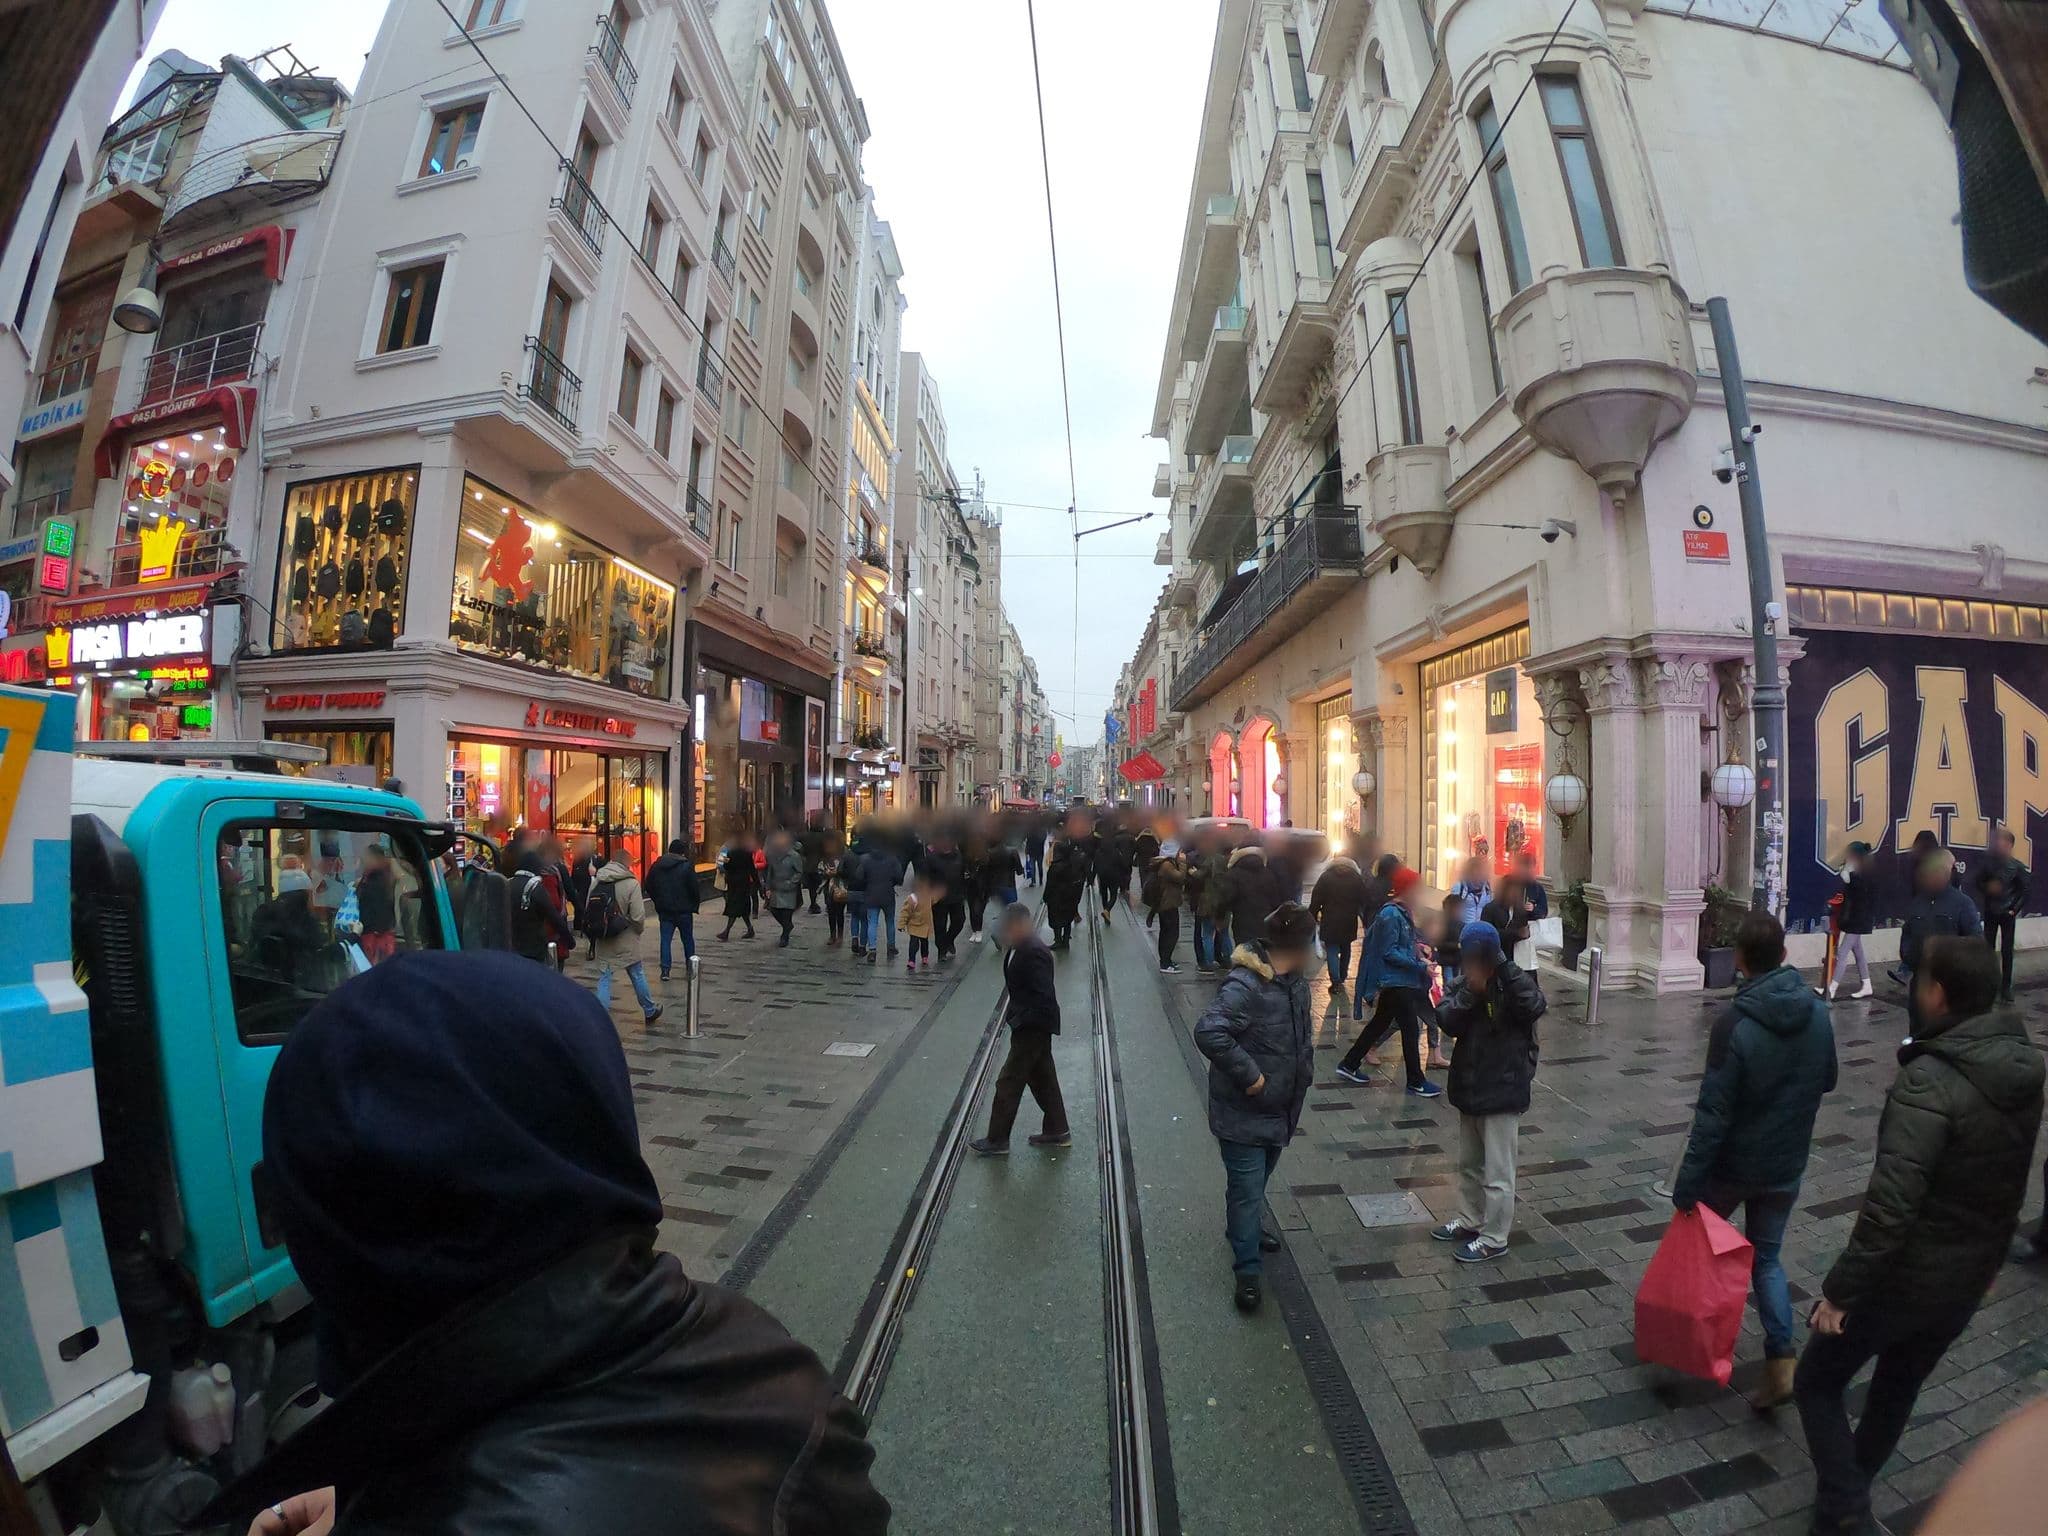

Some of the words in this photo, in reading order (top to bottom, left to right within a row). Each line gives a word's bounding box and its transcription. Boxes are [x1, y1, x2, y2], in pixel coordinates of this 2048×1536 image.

[21, 400, 83, 434] MEDİKAL
[1490, 690, 1507, 716] GAP
[1815, 665, 2048, 876] GAP
